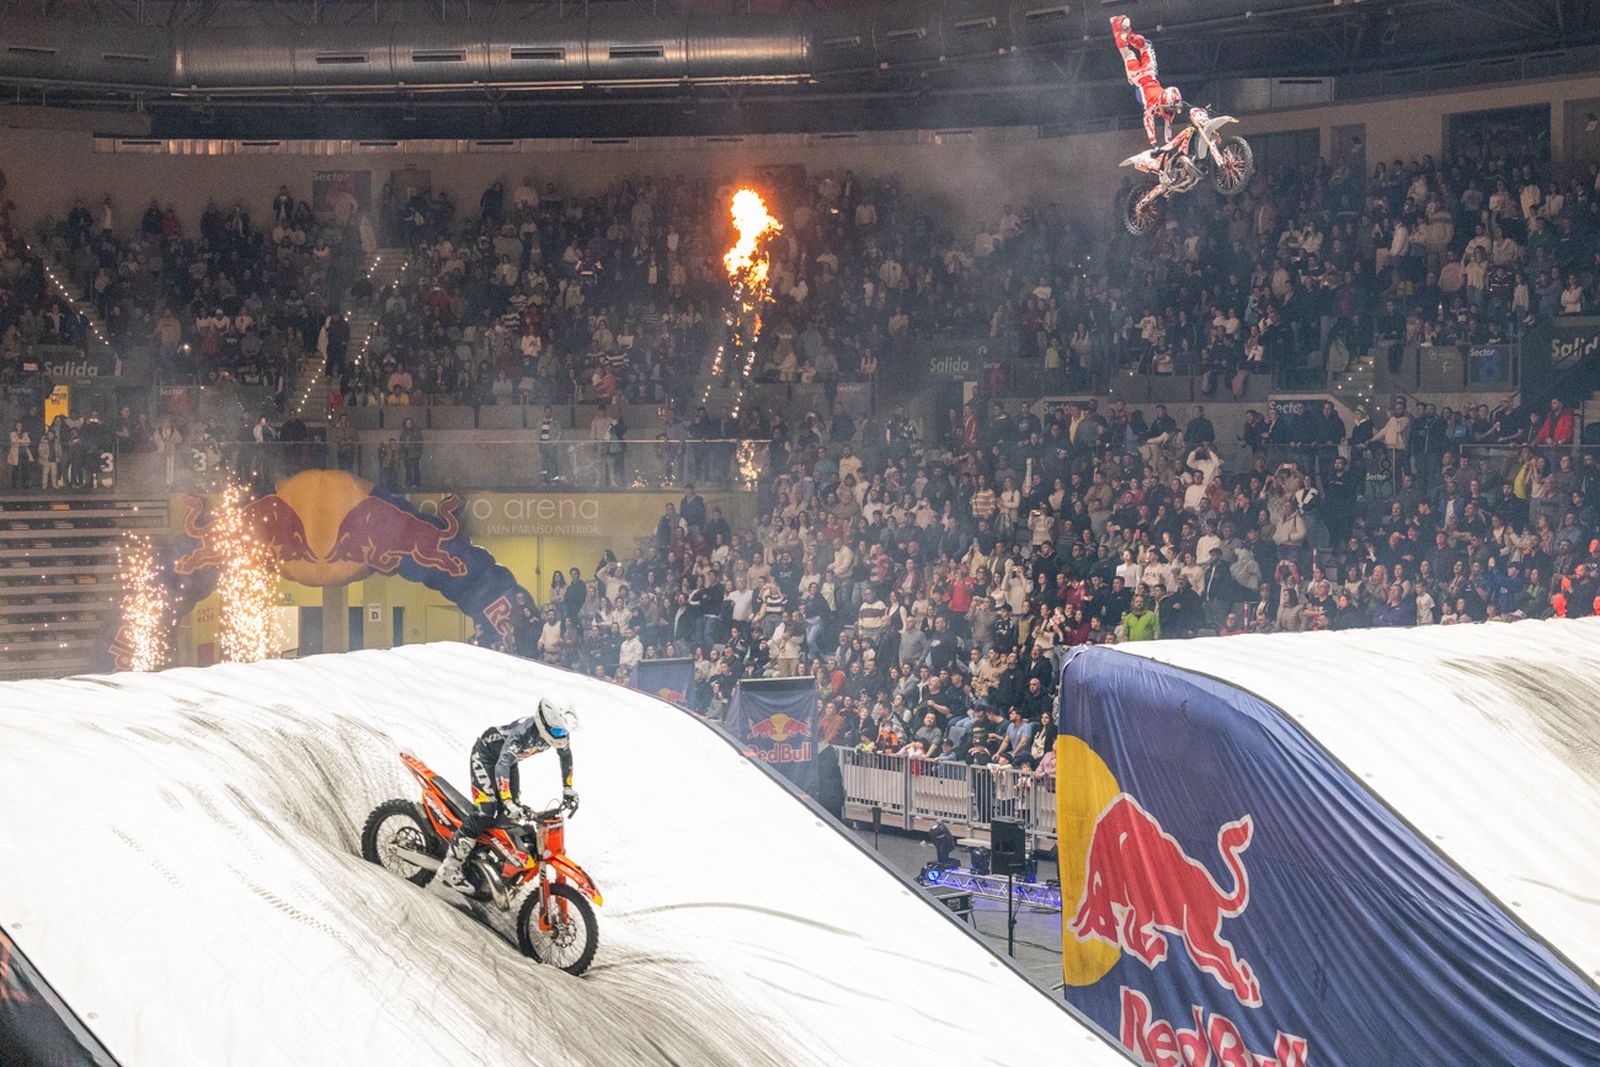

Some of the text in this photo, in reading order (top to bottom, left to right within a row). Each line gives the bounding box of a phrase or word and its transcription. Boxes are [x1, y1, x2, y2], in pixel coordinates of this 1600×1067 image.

[44, 360, 98, 377] Salida
[929, 356, 969, 373] Salida
[100, 452, 114, 472] 3
[191, 448, 207, 472] 3
[504, 499, 599, 519] arena
[779, 741, 812, 763] Bull
